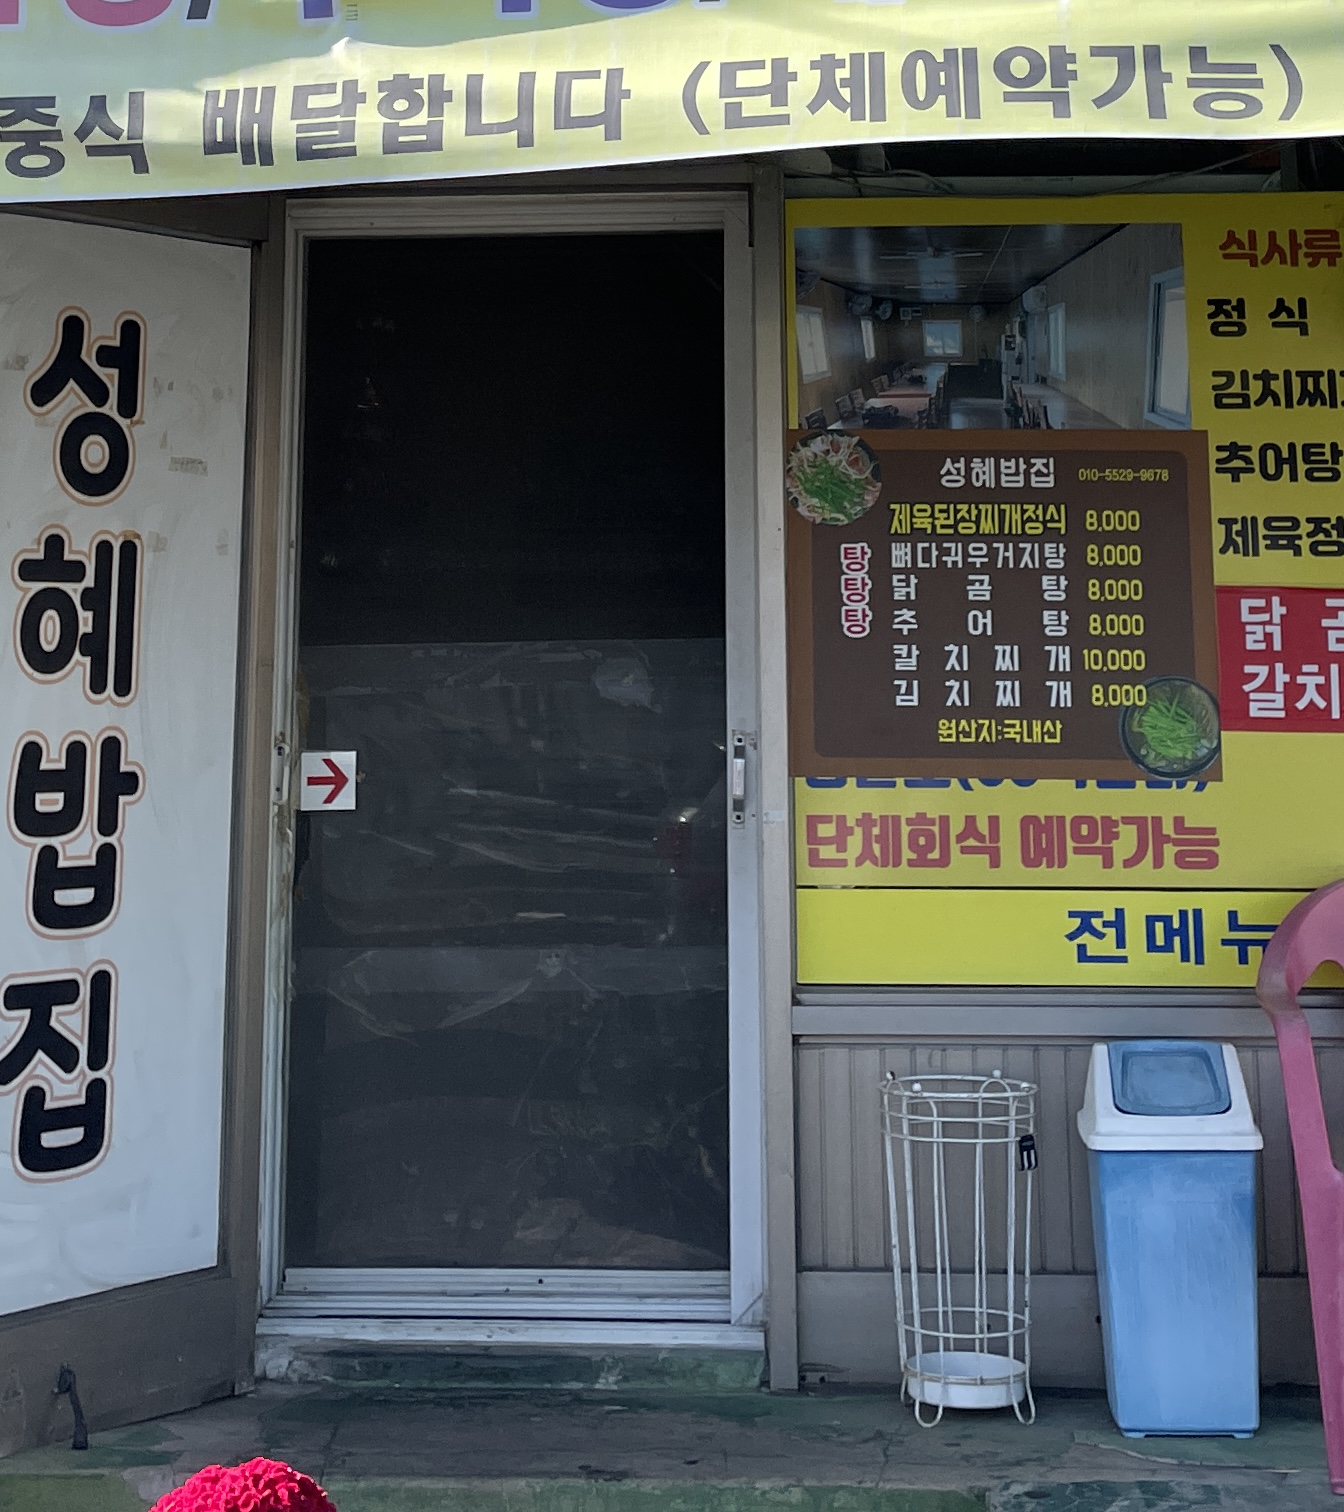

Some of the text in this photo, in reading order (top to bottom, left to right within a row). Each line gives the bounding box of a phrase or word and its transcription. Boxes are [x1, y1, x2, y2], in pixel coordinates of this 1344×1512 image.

[201, 66, 632, 166] 배달합니다
[681, 44, 1304, 137] (단체예약가능)
[1219, 229, 1343, 267] 식사류
[940, 457, 1170, 488] 성혜밥집 010-5529-9678
[1215, 441, 1344, 483] 추어탕
[889, 503, 1067, 535] 제육된장찌개정식
[890, 541, 1068, 569] 뼈다귀우거지탕
[804, 811, 1221, 871] 단체회식 예약가능
